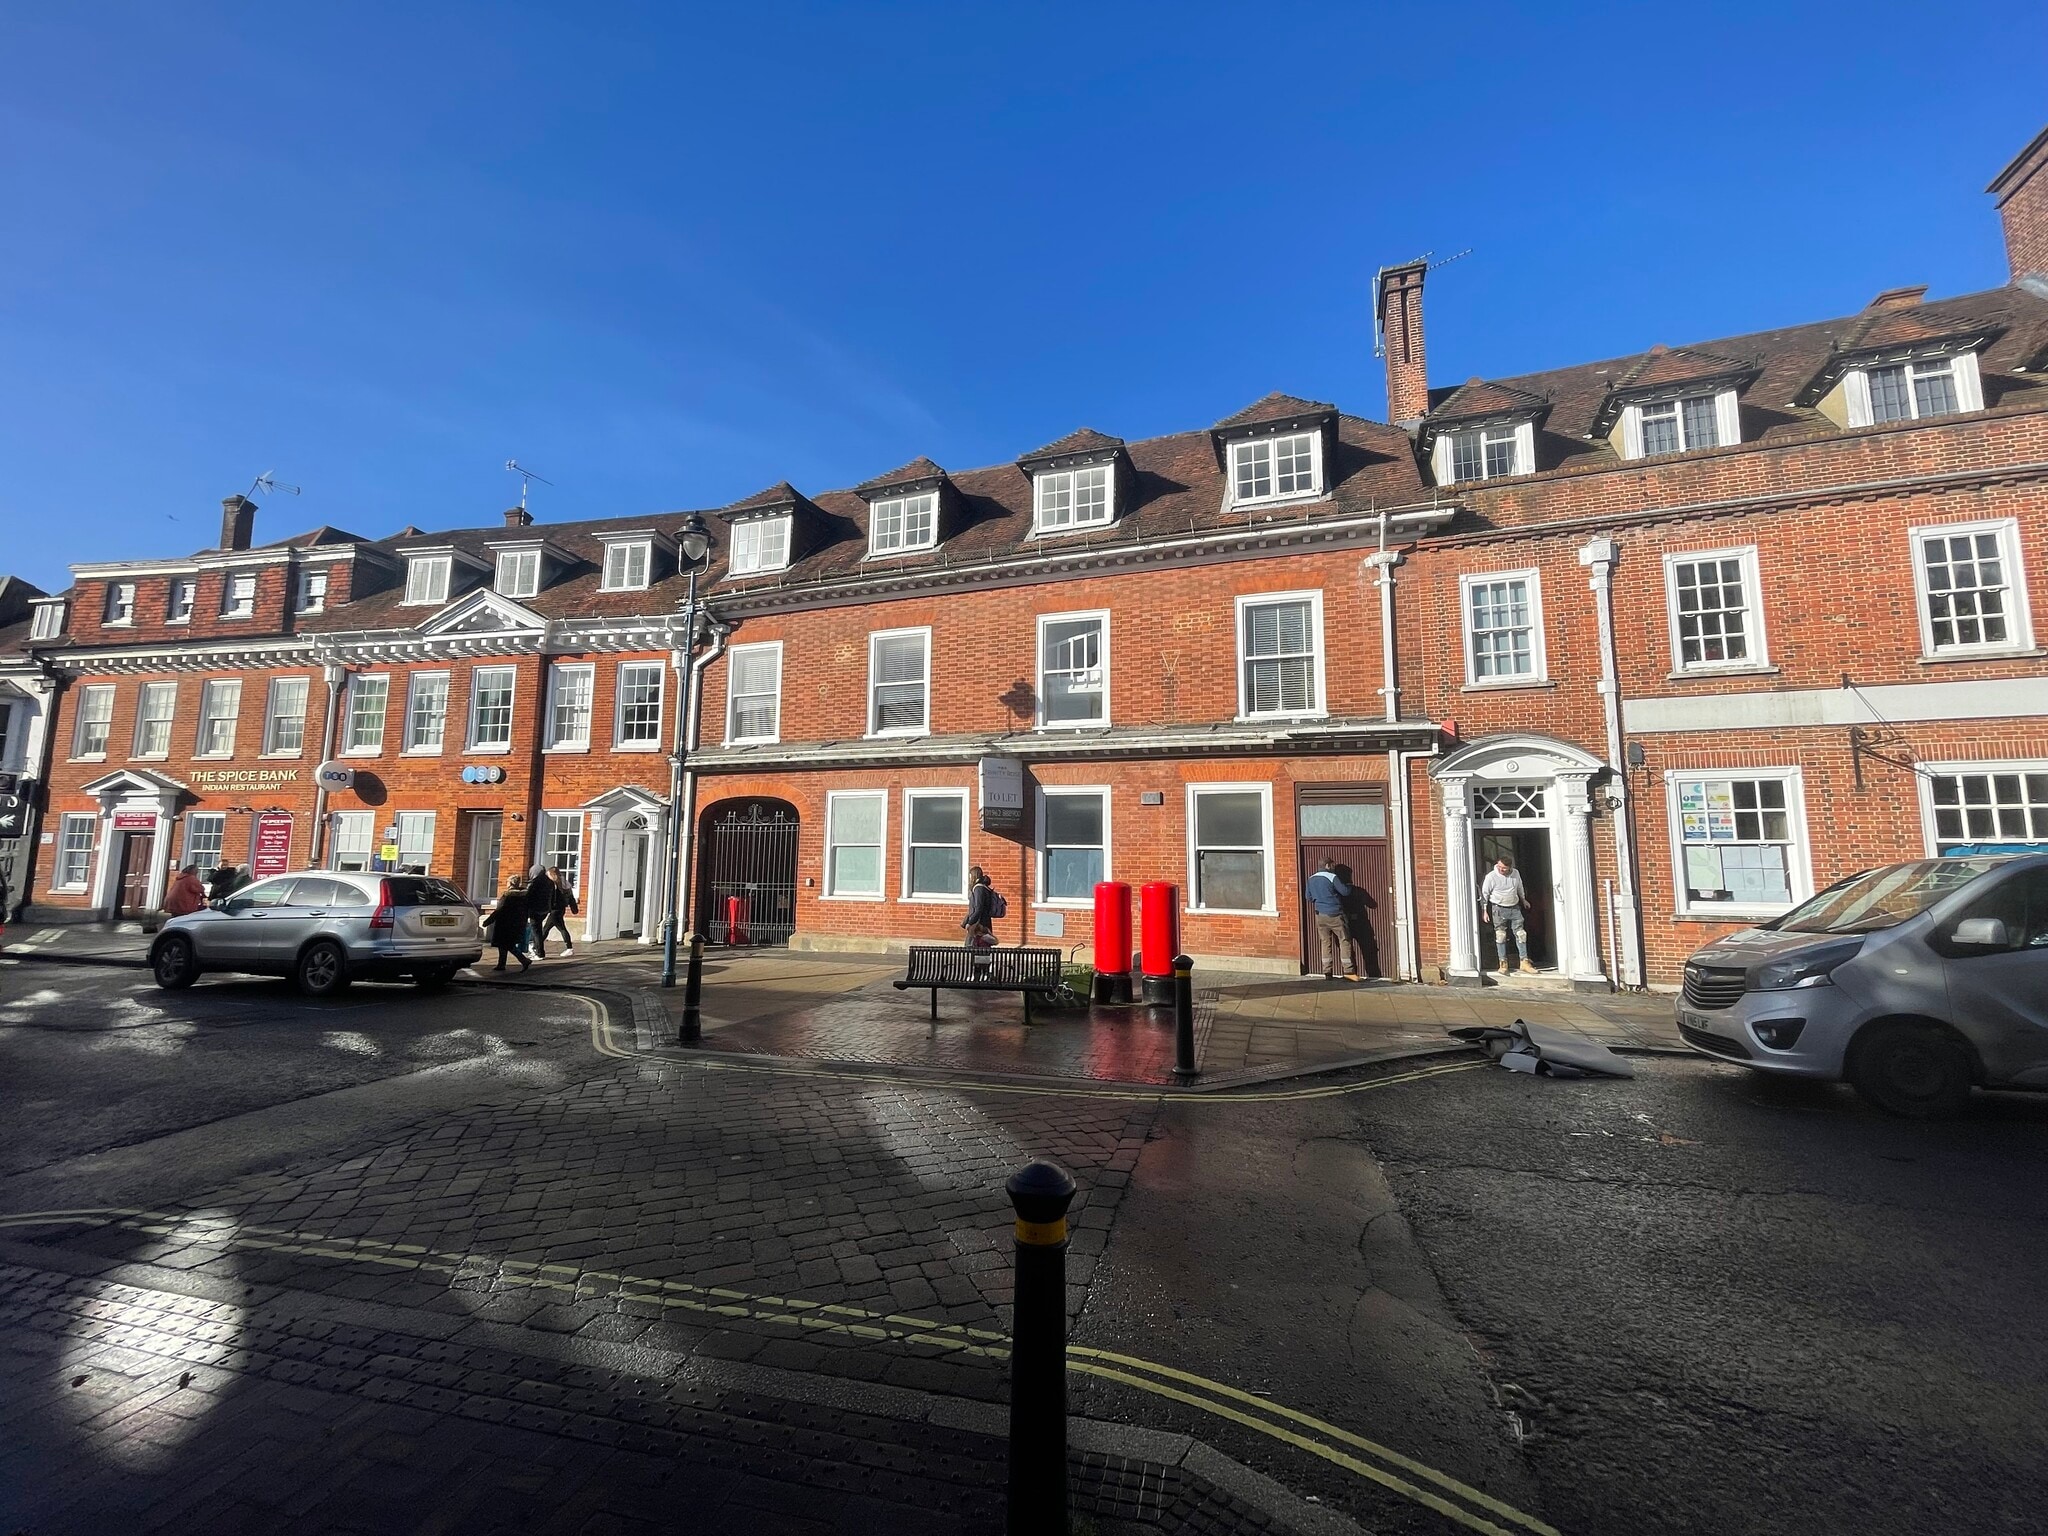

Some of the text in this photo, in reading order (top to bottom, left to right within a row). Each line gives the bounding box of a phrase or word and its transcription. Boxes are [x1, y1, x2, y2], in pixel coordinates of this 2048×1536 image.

[190, 769, 298, 782] THE SPICE BANK
[323, 771, 347, 781] TSB
[464, 767, 499, 781] TSB
[230, 783, 282, 791] RESTAURANT
[988, 792, 1018, 802] TO LET
